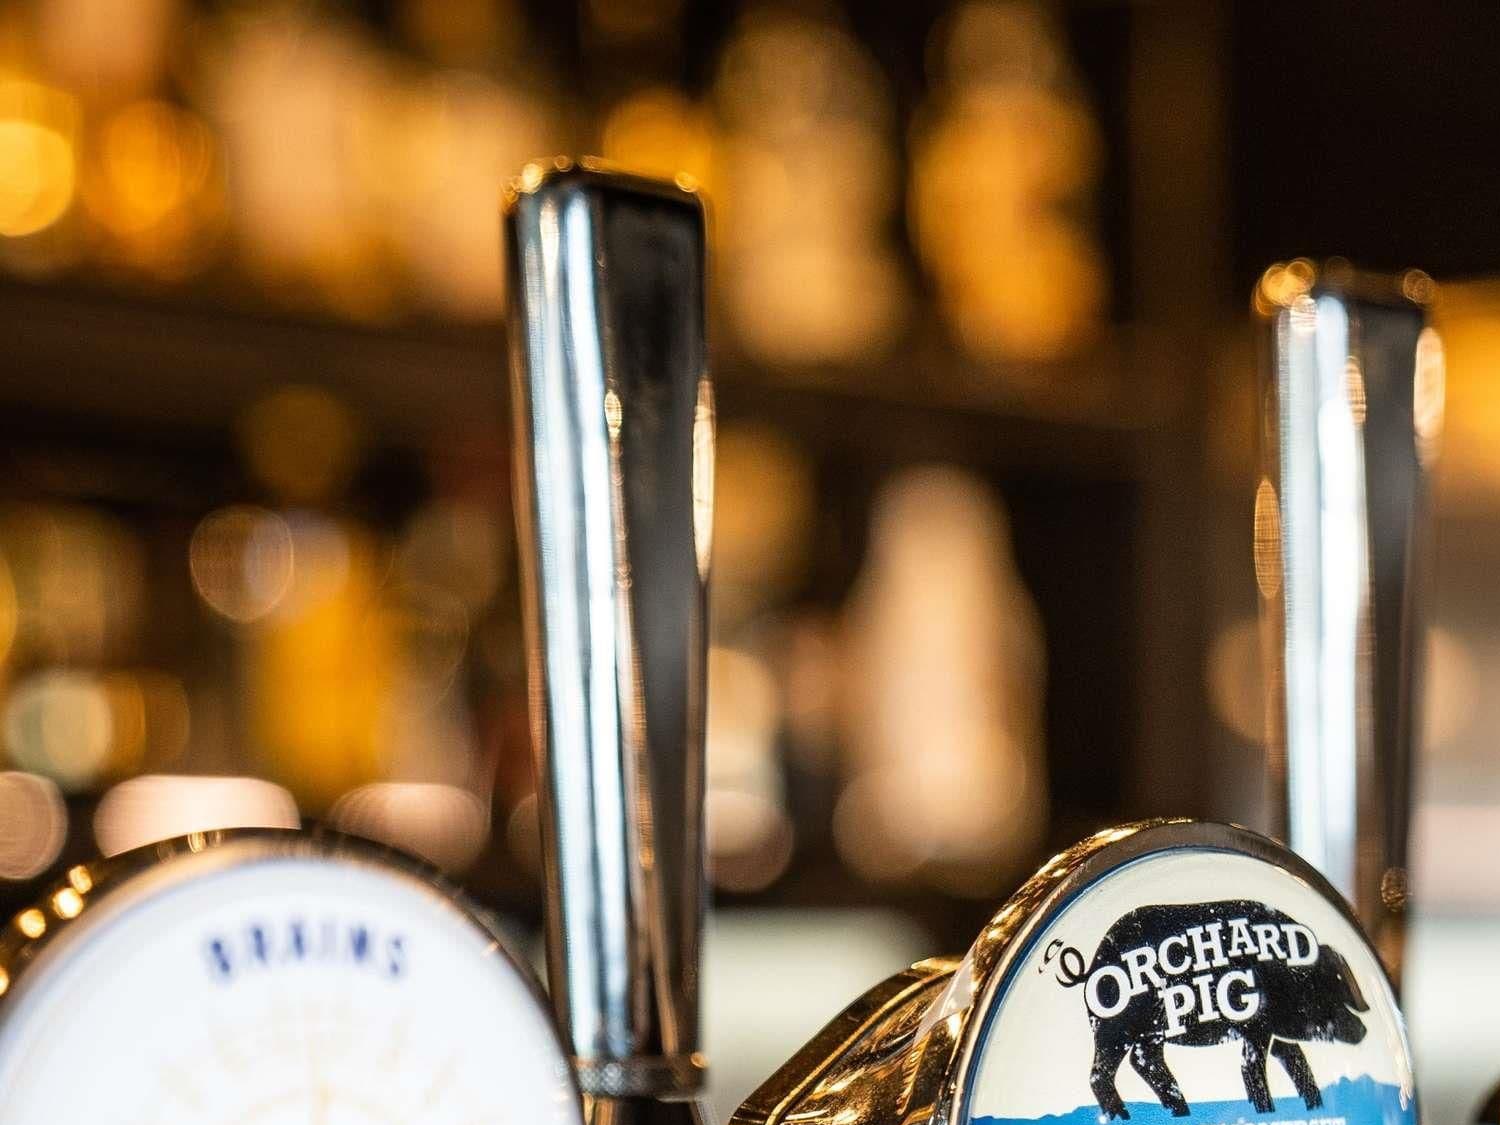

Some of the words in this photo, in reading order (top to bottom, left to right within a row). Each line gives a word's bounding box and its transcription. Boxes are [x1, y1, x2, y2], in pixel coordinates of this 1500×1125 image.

[208, 912, 408, 984] BRAINS
[1084, 917, 1319, 1019] ORCHARD
[1158, 969, 1260, 1038] PIG
